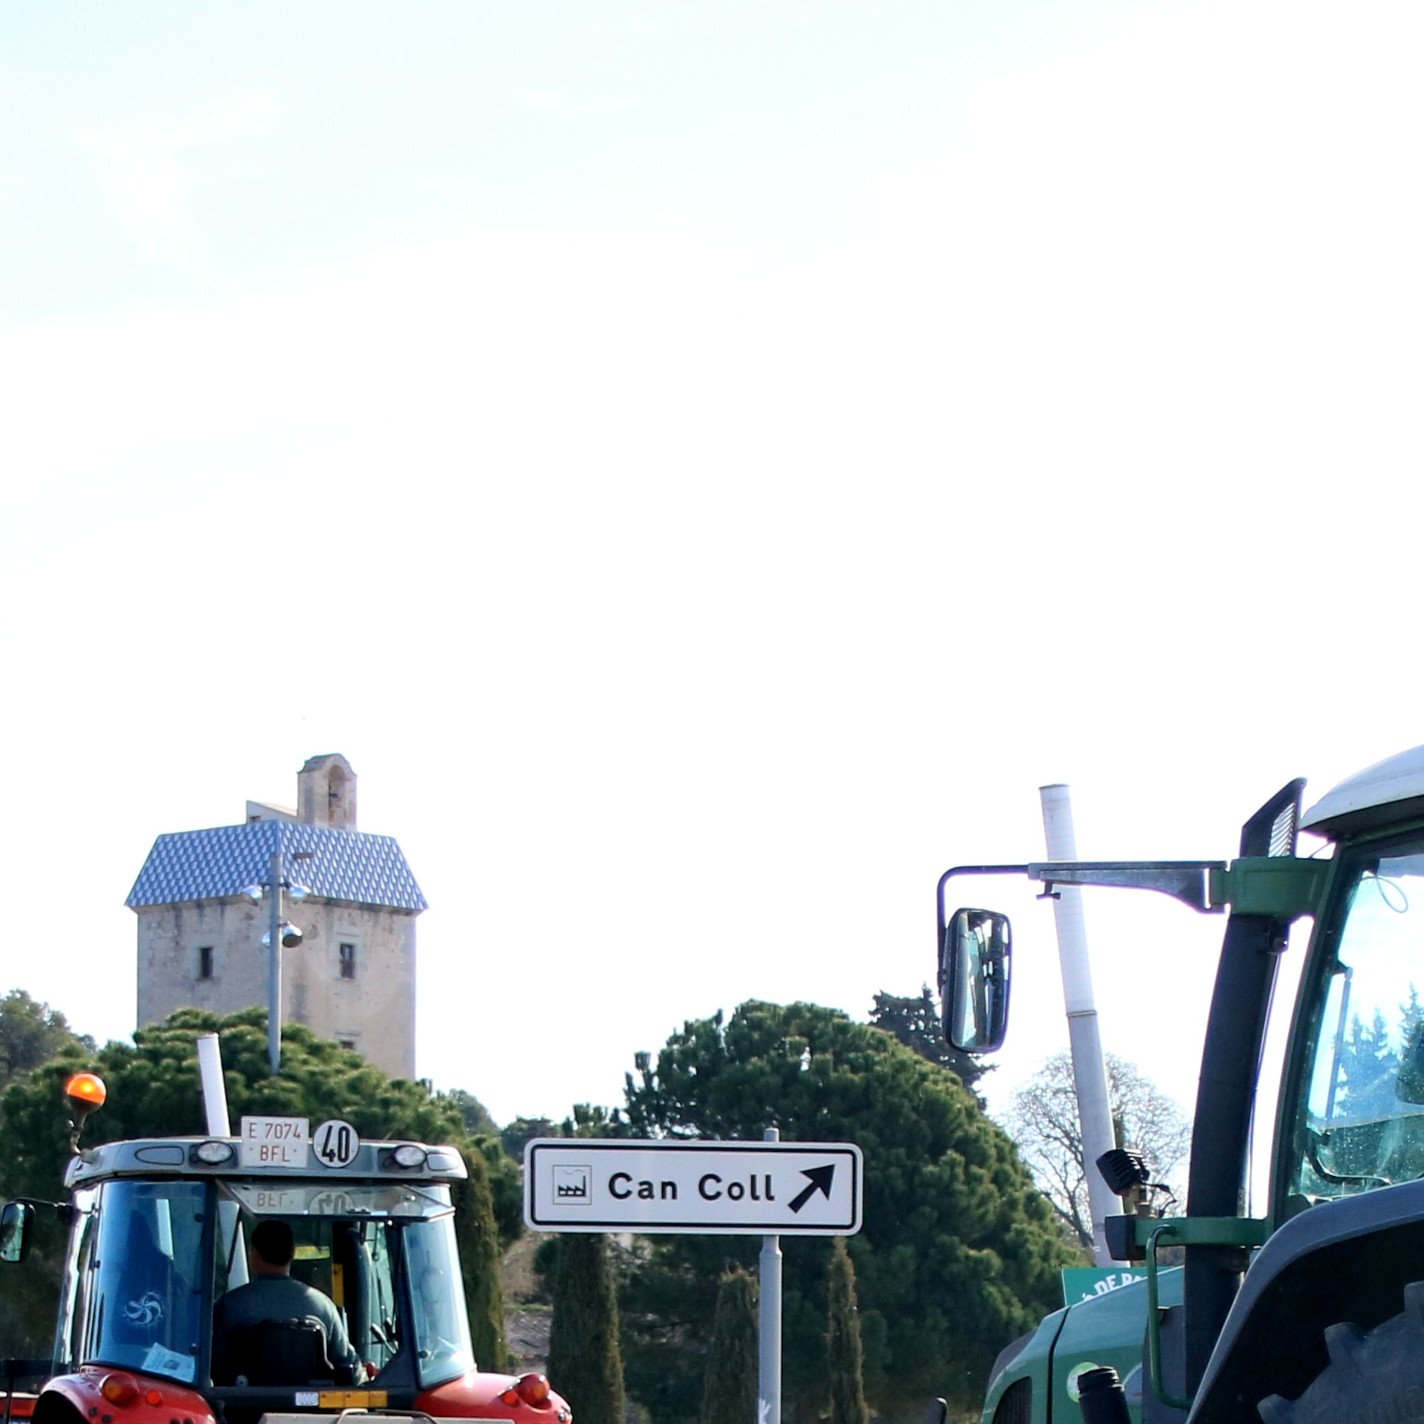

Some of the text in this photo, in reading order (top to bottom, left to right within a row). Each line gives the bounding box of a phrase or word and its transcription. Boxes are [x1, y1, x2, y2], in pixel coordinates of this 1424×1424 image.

[249, 1122, 301, 1139] E 7074
[260, 1145, 290, 1162] BFL
[321, 1125, 350, 1163] 40
[608, 1172, 775, 1201] Can Coll
